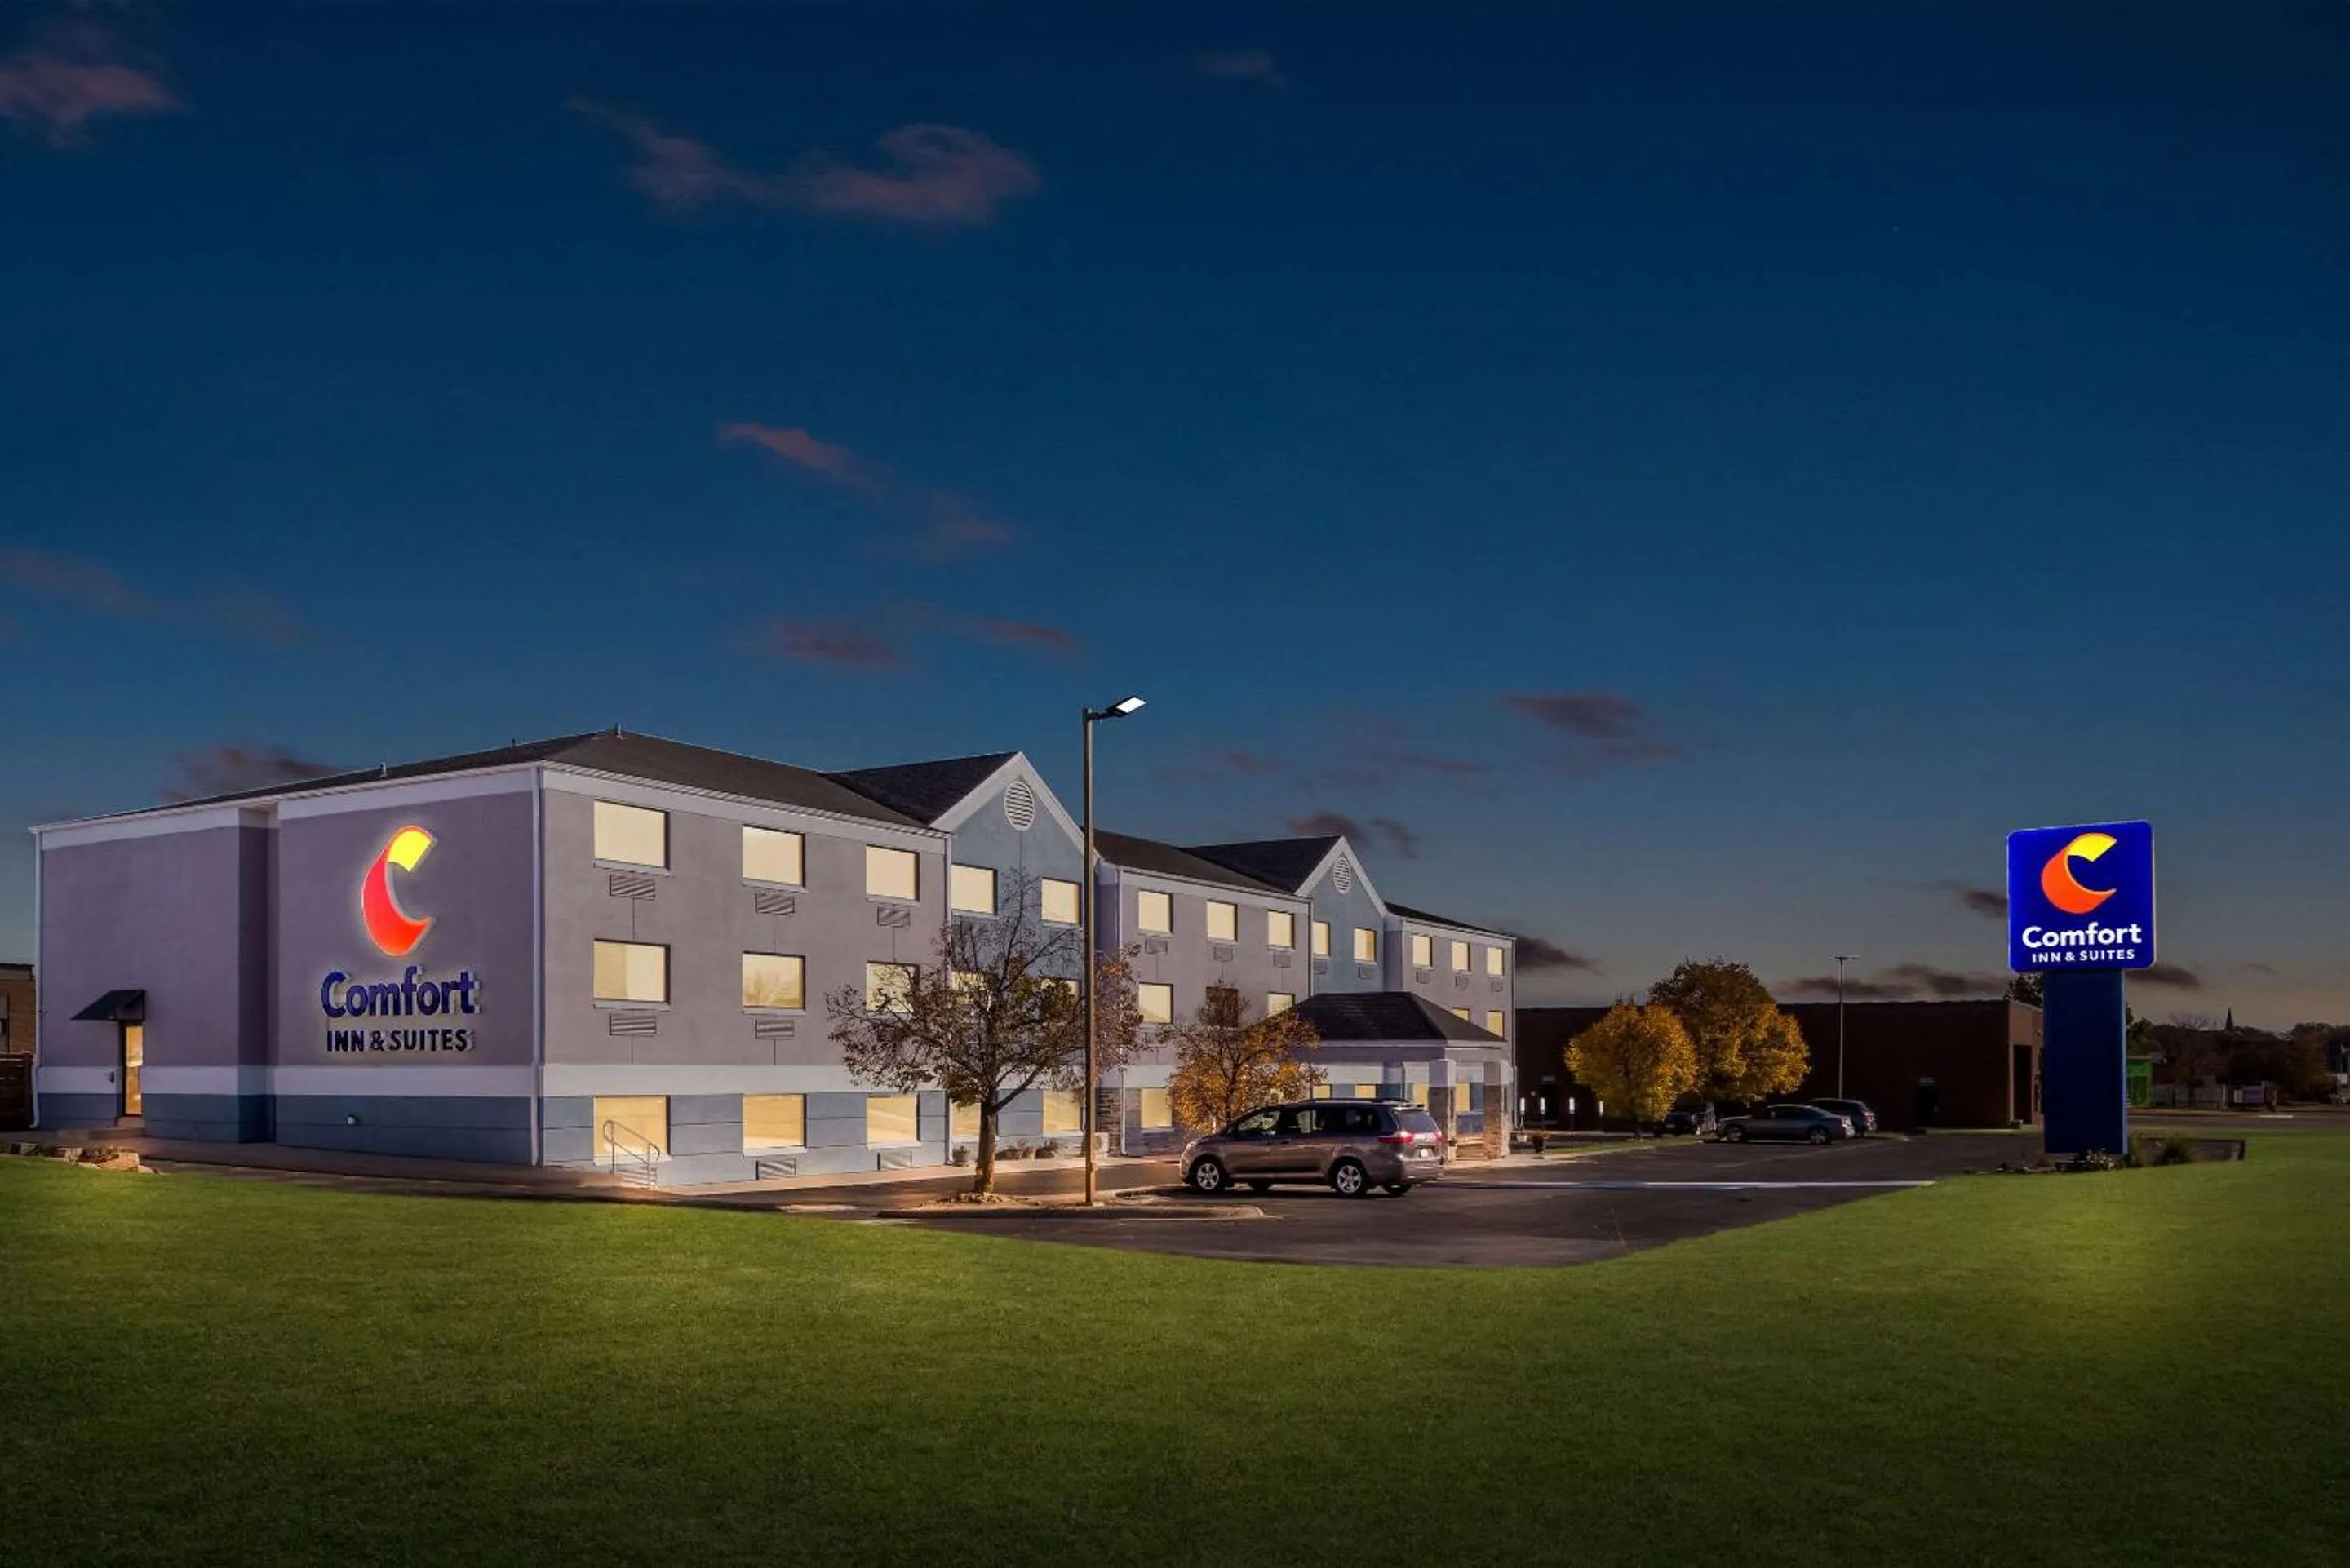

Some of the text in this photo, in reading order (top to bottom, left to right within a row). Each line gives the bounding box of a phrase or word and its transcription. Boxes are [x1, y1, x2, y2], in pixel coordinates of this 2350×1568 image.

[2023, 923, 2141, 948] Comfort
[2032, 949, 2135, 963] INN & SUITES
[321, 966, 477, 1017] Comfort
[327, 1029, 469, 1052] INN & SUITES
